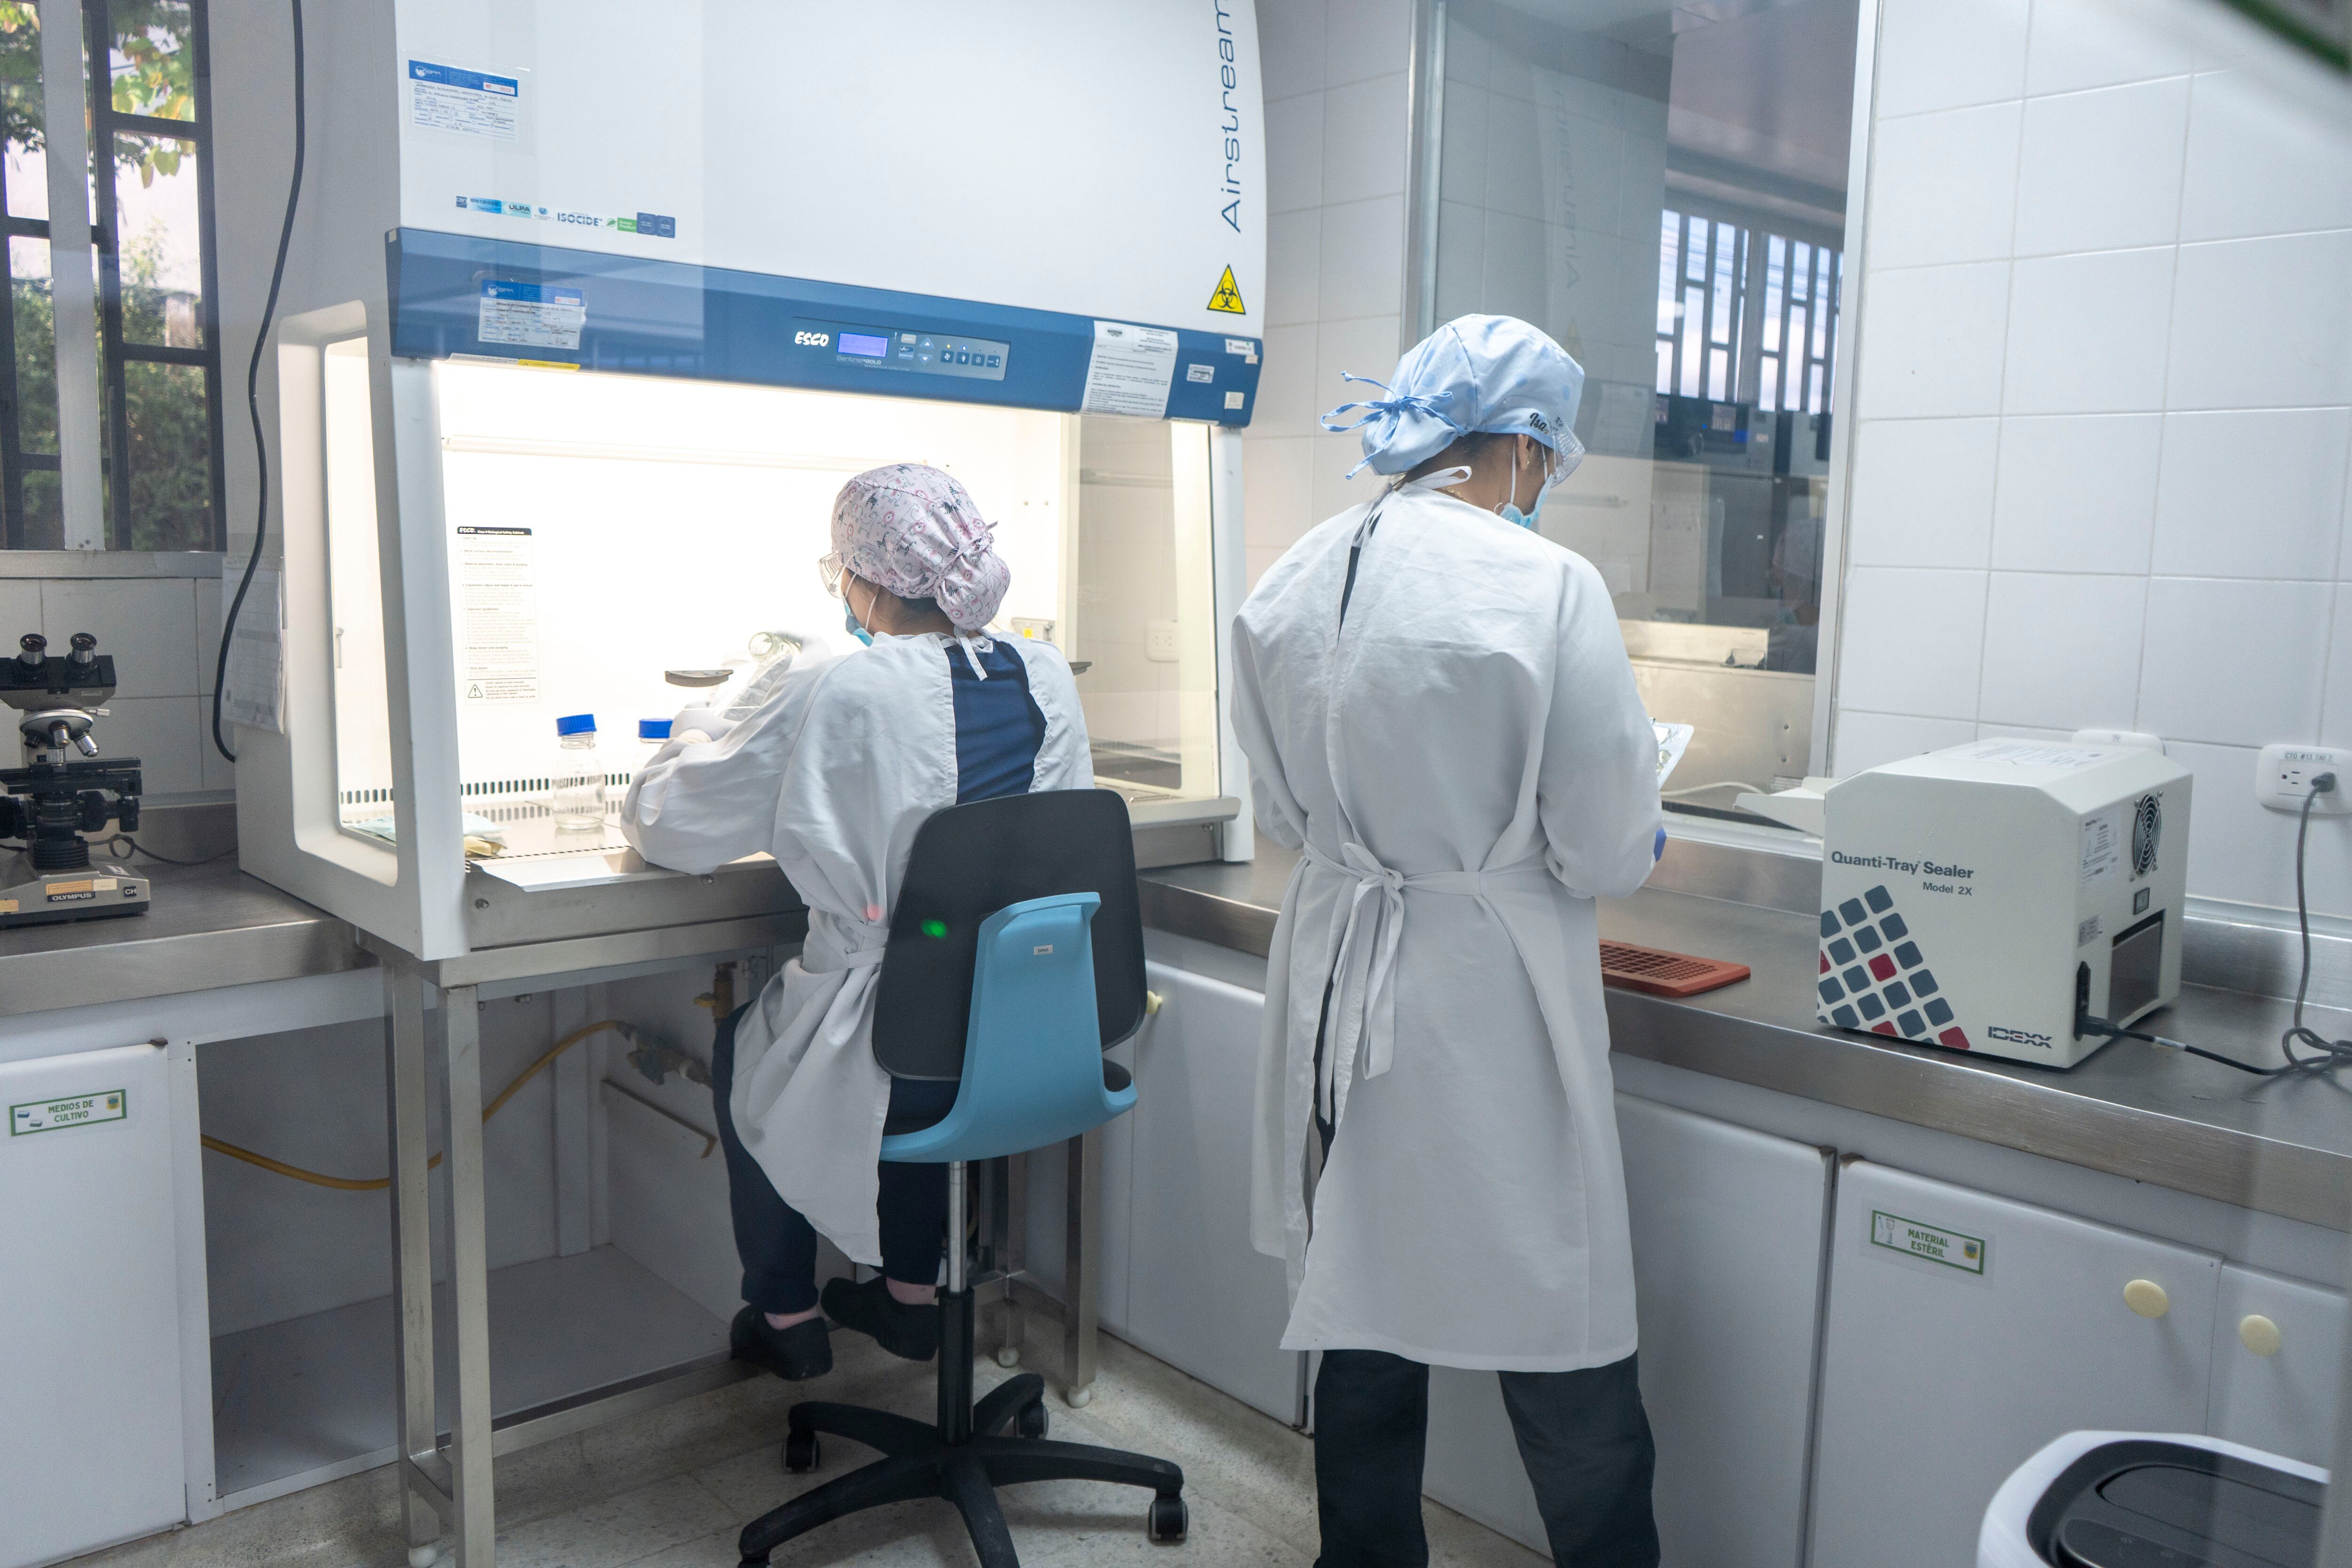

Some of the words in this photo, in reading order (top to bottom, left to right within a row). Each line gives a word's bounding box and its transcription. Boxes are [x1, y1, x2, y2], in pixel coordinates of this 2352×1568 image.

[509, 204, 530, 212] ULPA
[794, 331, 829, 347] ESCO
[1530, 412, 1547, 431] Isa
[1923, 861, 1974, 879] Sealer
[52, 892, 92, 901] OLYMPUS
[1923, 882, 1954, 893] Model
[1958, 886, 1972, 896] 2X
[1987, 1026, 2053, 1049] IDEXX
[48, 1101, 80, 1114] MEDIOS
[82, 1099, 94, 1108] DE
[54, 1110, 89, 1123] CULTIVO
[1908, 1228, 1950, 1248] MATERIAL
[1911, 1241, 1945, 1258] ESTÉRIL
